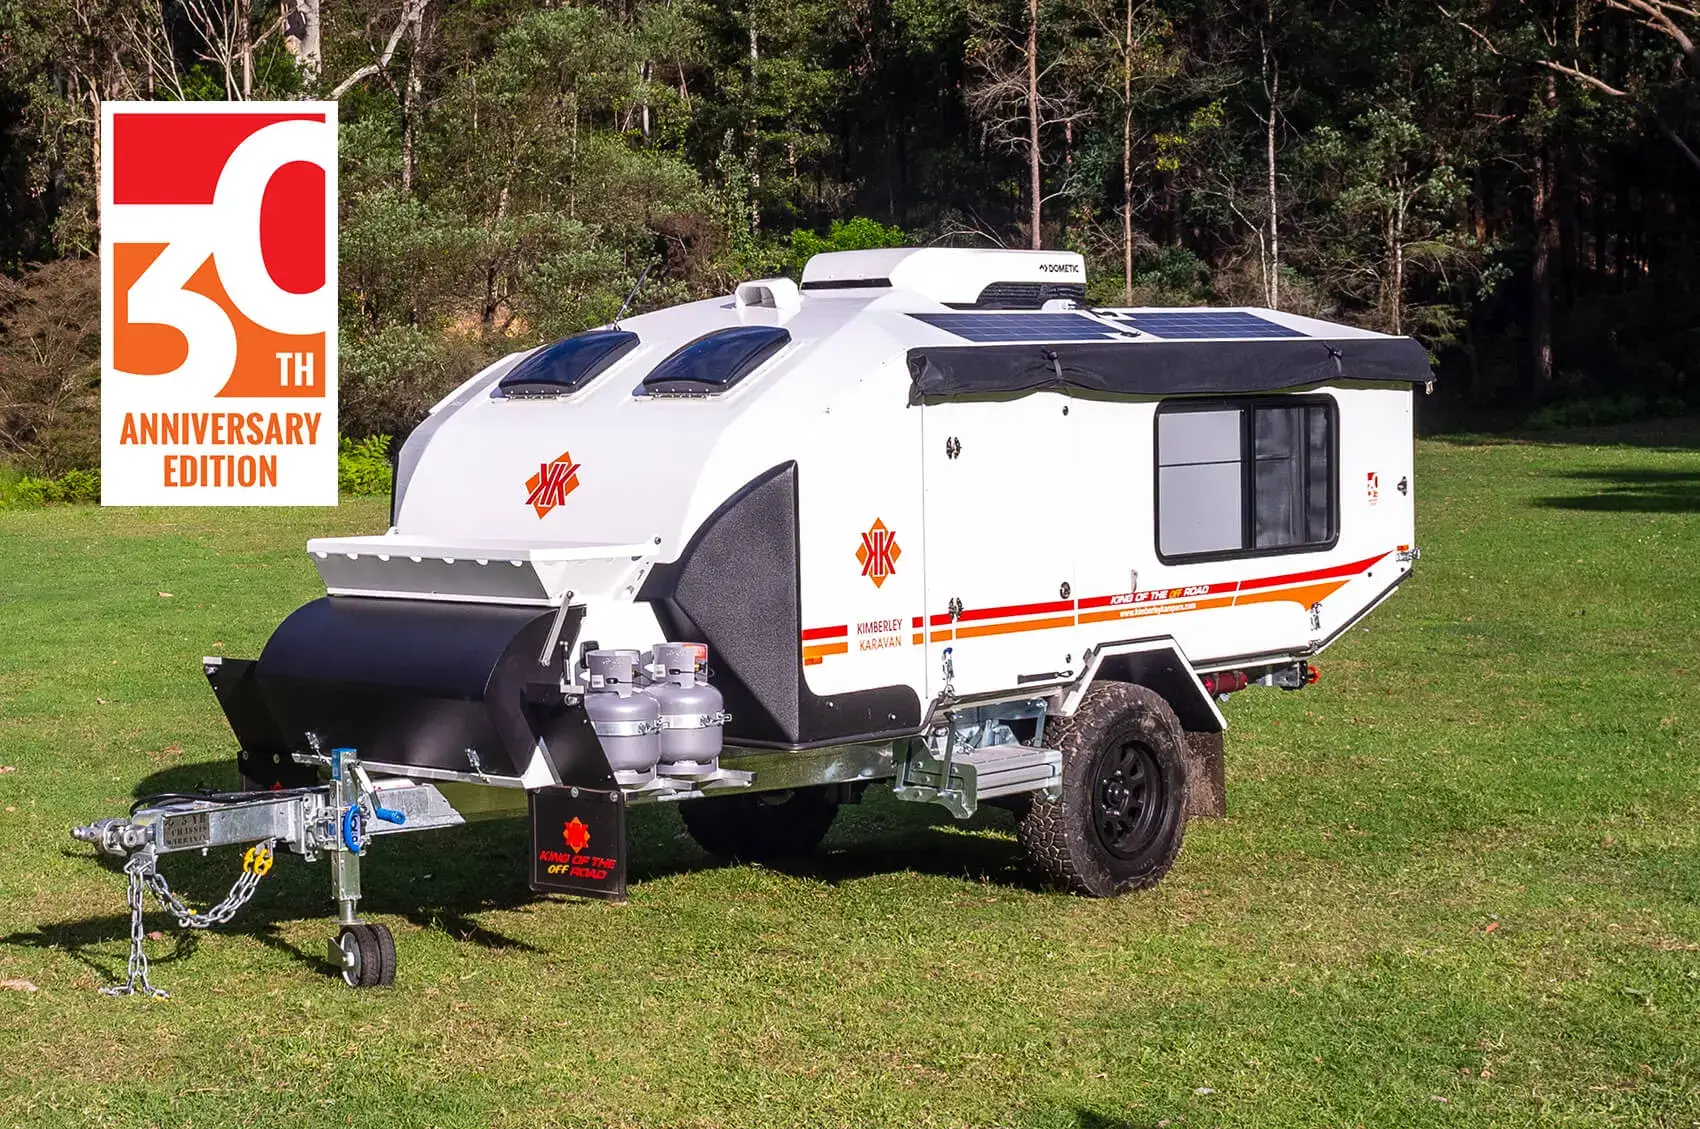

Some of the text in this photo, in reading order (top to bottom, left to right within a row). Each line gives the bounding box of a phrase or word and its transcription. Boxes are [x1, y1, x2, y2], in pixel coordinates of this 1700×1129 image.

[1048, 264, 1079, 273] DOMETIC
[1110, 585, 1209, 605] KING OF THE OFF ROAD
[857, 618, 902, 635] KIMBERLEY
[859, 636, 901, 651] KARAVAN
[539, 850, 617, 869] KING OF THE
[547, 864, 608, 880] OFF ROAD
